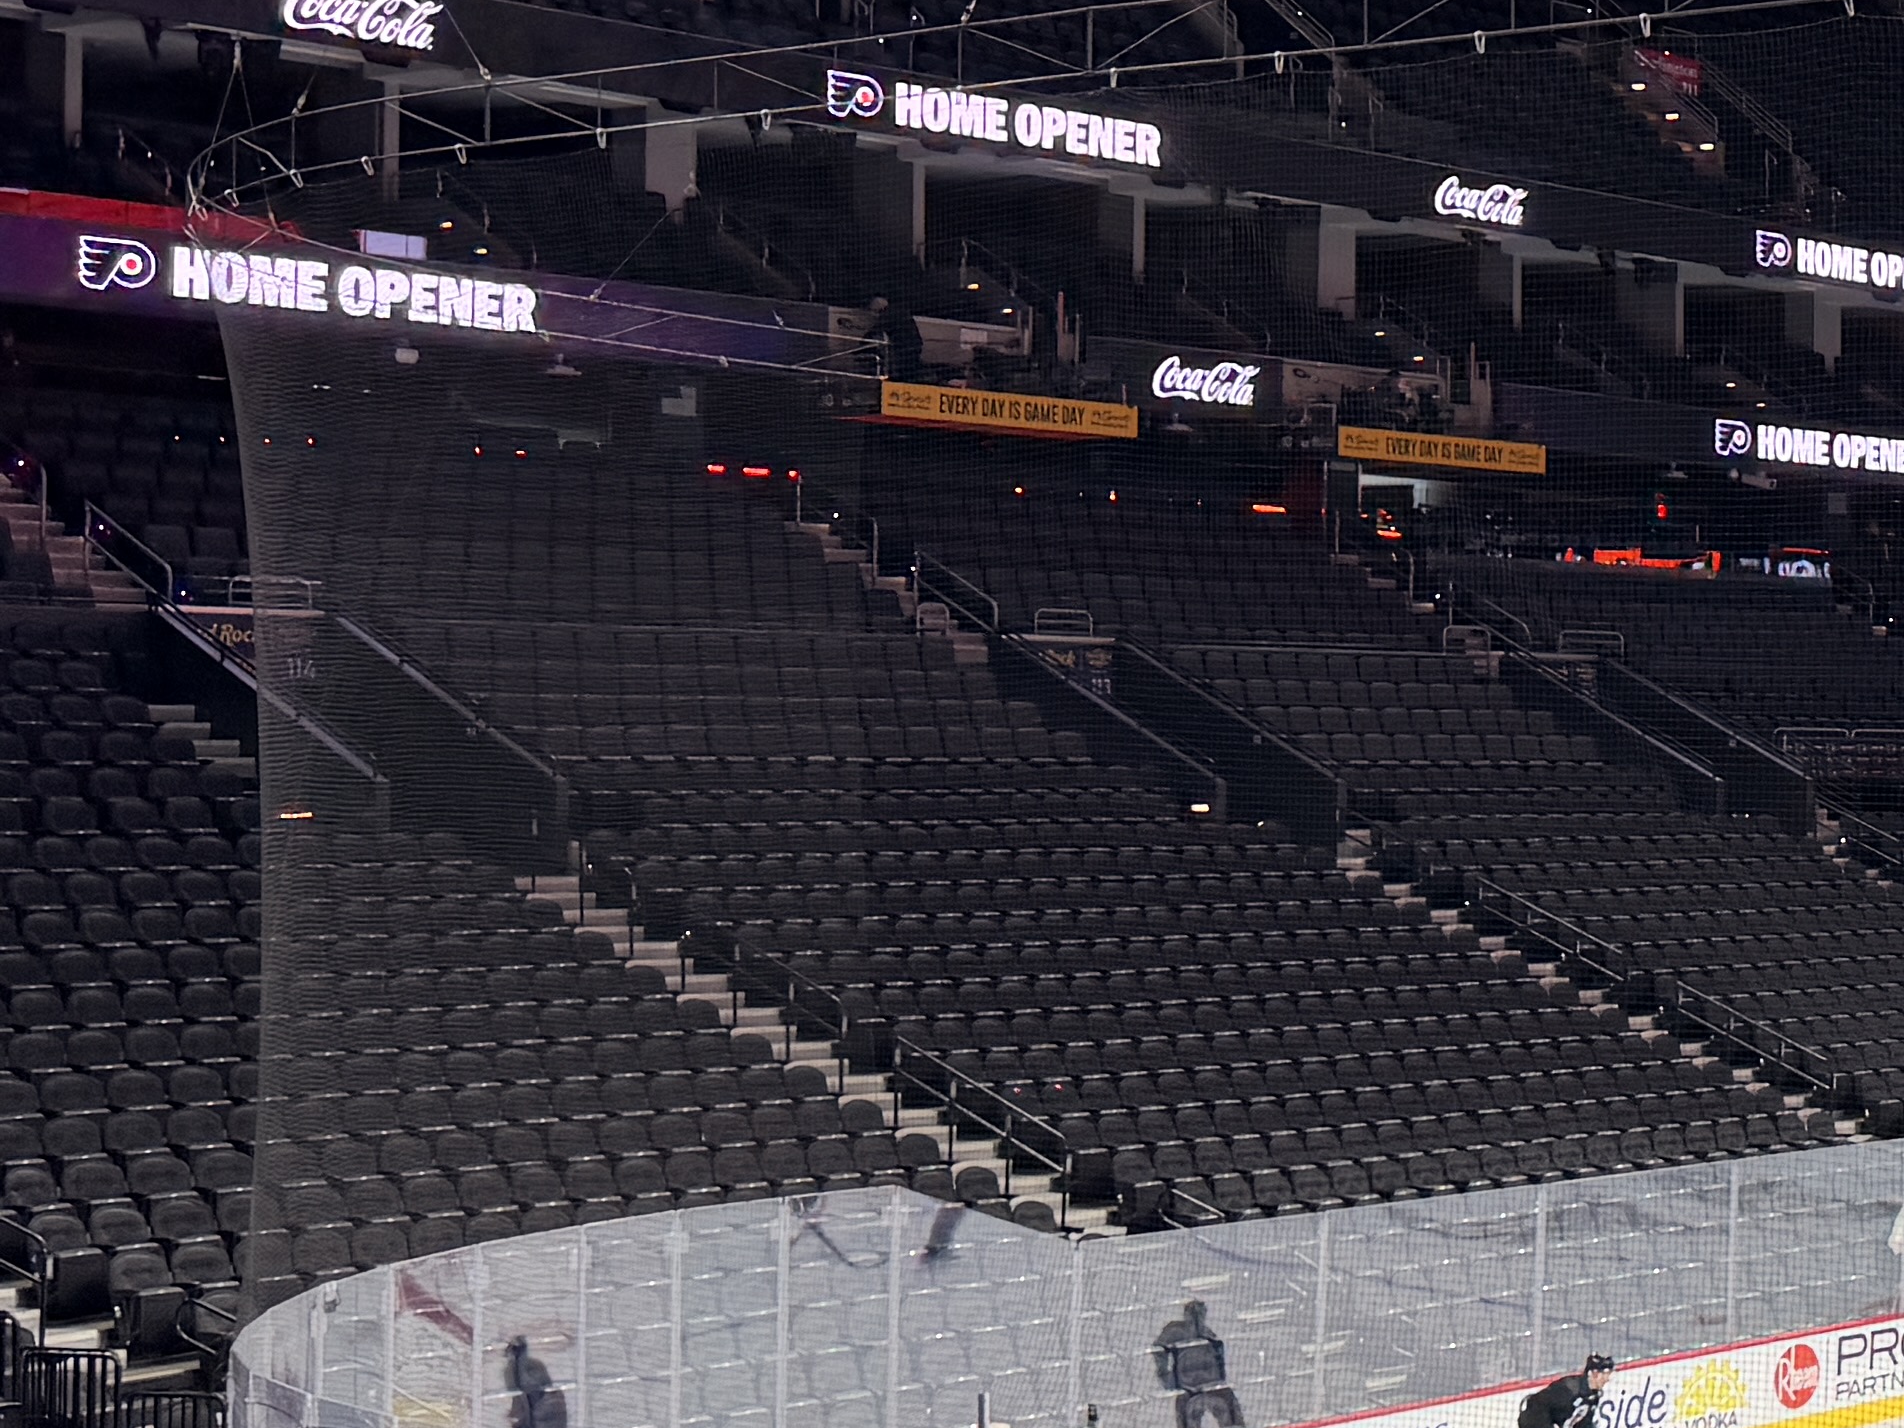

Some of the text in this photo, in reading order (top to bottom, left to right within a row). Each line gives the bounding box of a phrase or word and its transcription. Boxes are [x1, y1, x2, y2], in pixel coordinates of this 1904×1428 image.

[895, 82, 1161, 167] HOME OPENER
[1434, 175, 1529, 227] Coca-Cola
[1797, 237, 1868, 283] HOME
[172, 246, 537, 333] HOME OPENER
[1152, 355, 1262, 407] Coca-Cola
[939, 392, 978, 418] EVERY
[981, 396, 1006, 420] DAY
[1008, 399, 1021, 420] IS
[1024, 400, 1059, 424] GAME
[1061, 403, 1086, 427] DAY
[1757, 424, 1831, 466] HOME
